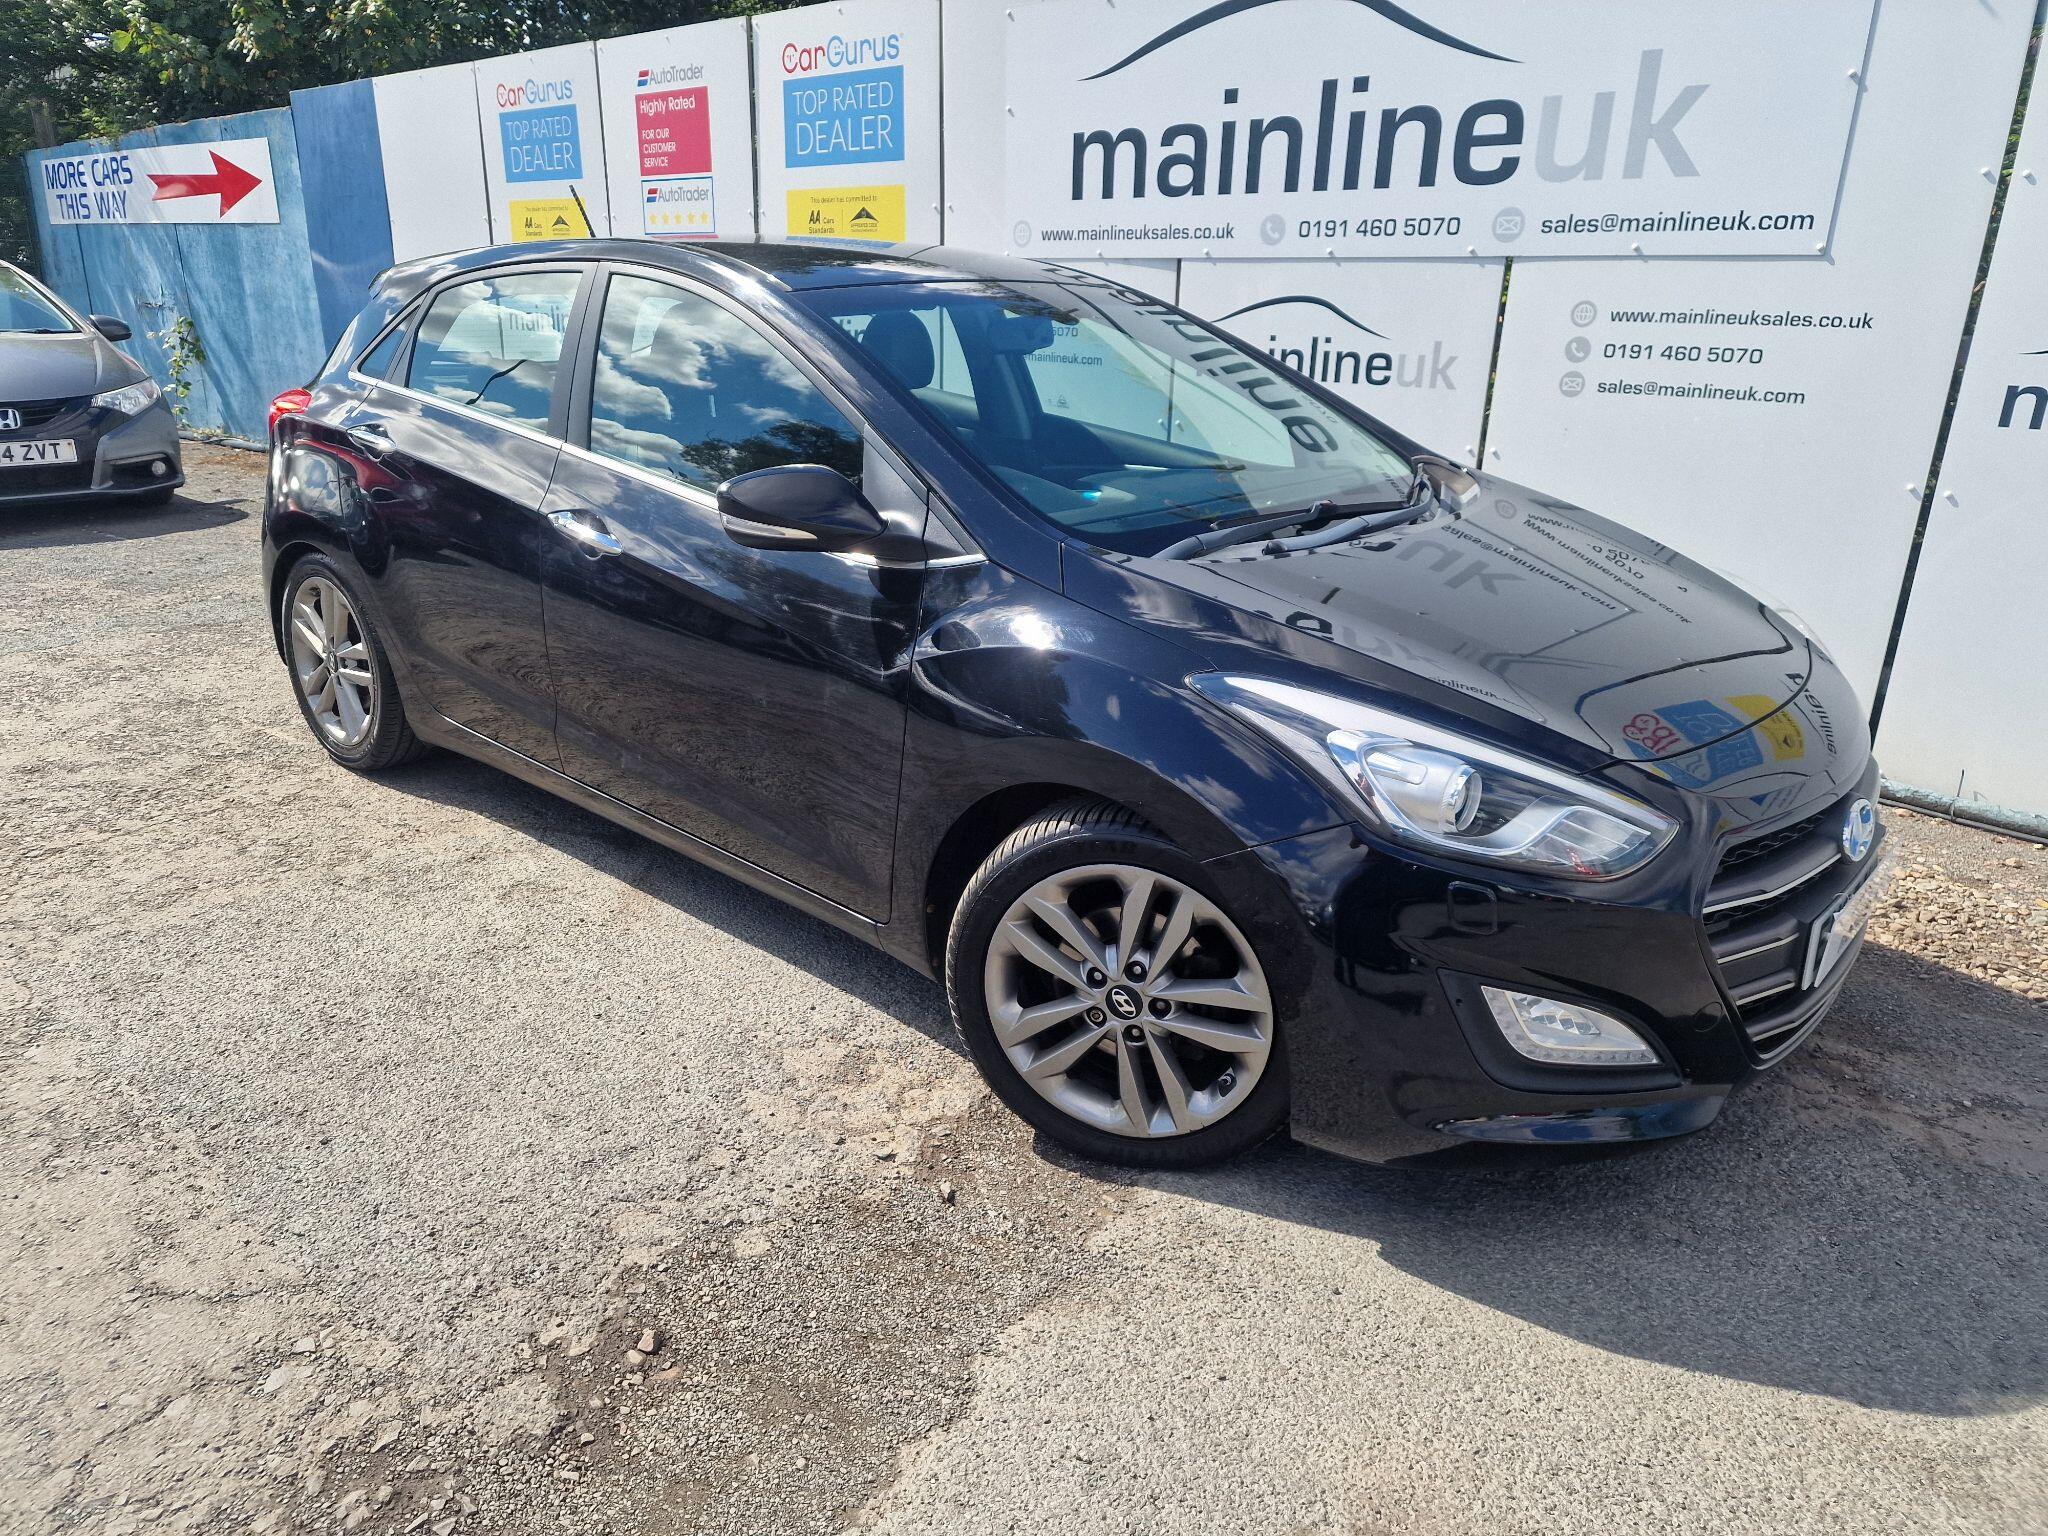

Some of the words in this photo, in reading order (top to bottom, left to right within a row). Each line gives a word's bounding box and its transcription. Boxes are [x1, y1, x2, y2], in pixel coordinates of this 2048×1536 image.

[782, 34, 900, 73] CarGurus
[649, 64, 704, 85] AutoTrader
[497, 79, 573, 107] CarGurus
[792, 89, 828, 115] TOP
[833, 81, 894, 112] RATED
[640, 100, 667, 116] Highly
[668, 94, 696, 111] Rated
[505, 120, 530, 141] TOP
[532, 115, 572, 138] RATED
[642, 129, 655, 140] FOR
[656, 128, 670, 139] OUR
[796, 114, 894, 155] DEALER
[1071, 48, 1711, 202] mainlineuk
[510, 142, 575, 173] DEALER
[643, 142, 677, 154] CUSTOMER
[45, 160, 87, 190] MORE
[91, 155, 133, 187] CARS
[644, 157, 669, 168] SERVICE
[56, 192, 91, 219] THIS
[93, 190, 127, 219] WAY
[658, 186, 709, 203] AutoTrader
[808, 210, 820, 224] AA
[1299, 219, 1348, 238] 0191
[1356, 218, 1397, 237] 460
[1403, 217, 1461, 236] 5070
[1540, 210, 1815, 235] sales@mainlineuk.com
[1041, 222, 1235, 241] www.mainlineuksales.co.uk
[1610, 308, 1874, 330] www.mainlineuksales.co.uk
[1603, 343, 1653, 360] 0191
[1660, 344, 1701, 362] 460
[1707, 346, 1763, 364] 5070
[1597, 379, 1806, 404] sales@mainlineuk.com
[20, 442, 60, 461] ZVT
